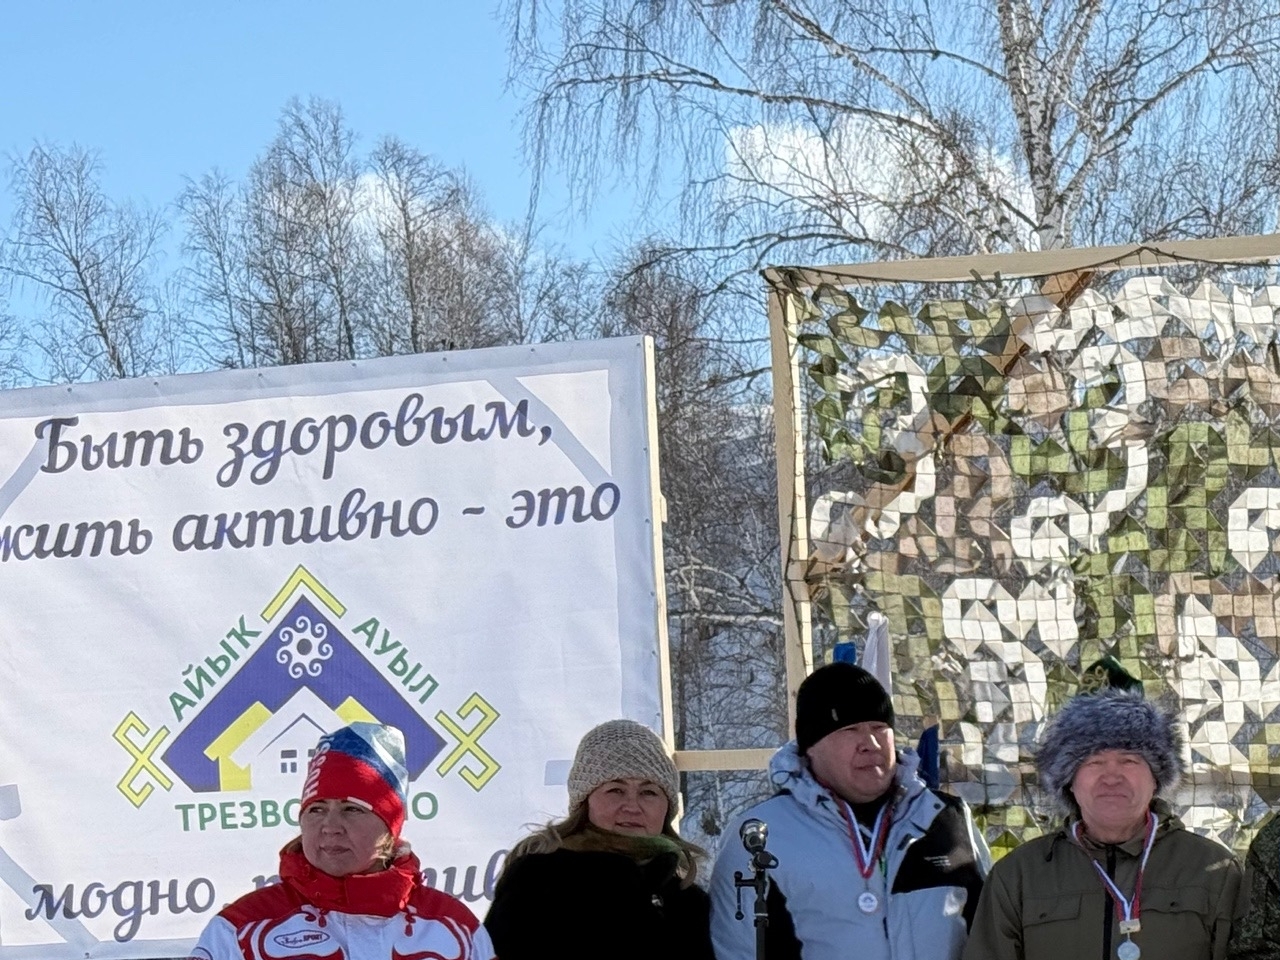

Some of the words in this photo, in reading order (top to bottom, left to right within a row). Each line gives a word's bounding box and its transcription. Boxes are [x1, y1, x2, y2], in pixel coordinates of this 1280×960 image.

[34, 415, 204, 474] Быть
[215, 393, 552, 488] здоровым,
[172, 488, 439, 552] активно
[505, 482, 621, 529] это
[351, 617, 440, 704] АУЫЛ
[175, 798, 302, 831] ТРЕЗВО
